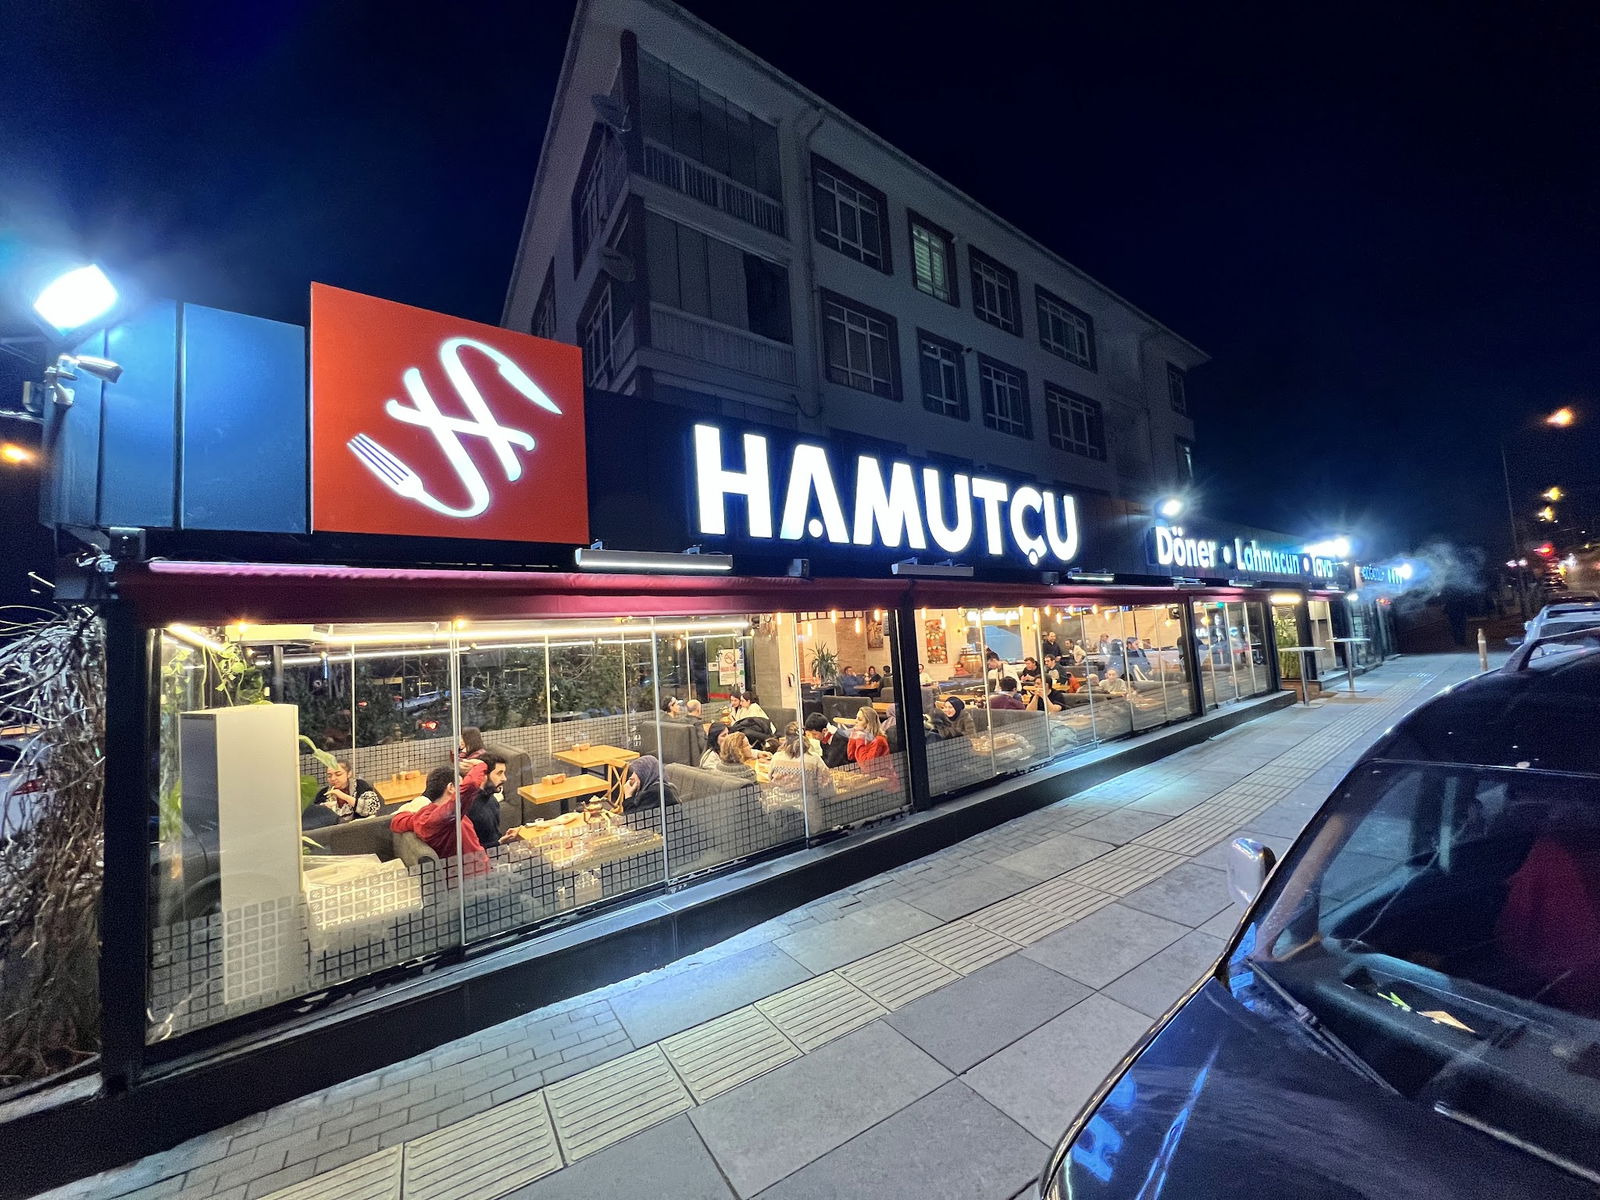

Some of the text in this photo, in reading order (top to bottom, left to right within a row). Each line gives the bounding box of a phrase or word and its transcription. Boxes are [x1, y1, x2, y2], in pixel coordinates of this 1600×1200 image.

[694, 423, 1079, 566] HAMUTÇU
[1155, 525, 1216, 569] Döner
[1234, 537, 1300, 575] Lahmacun
